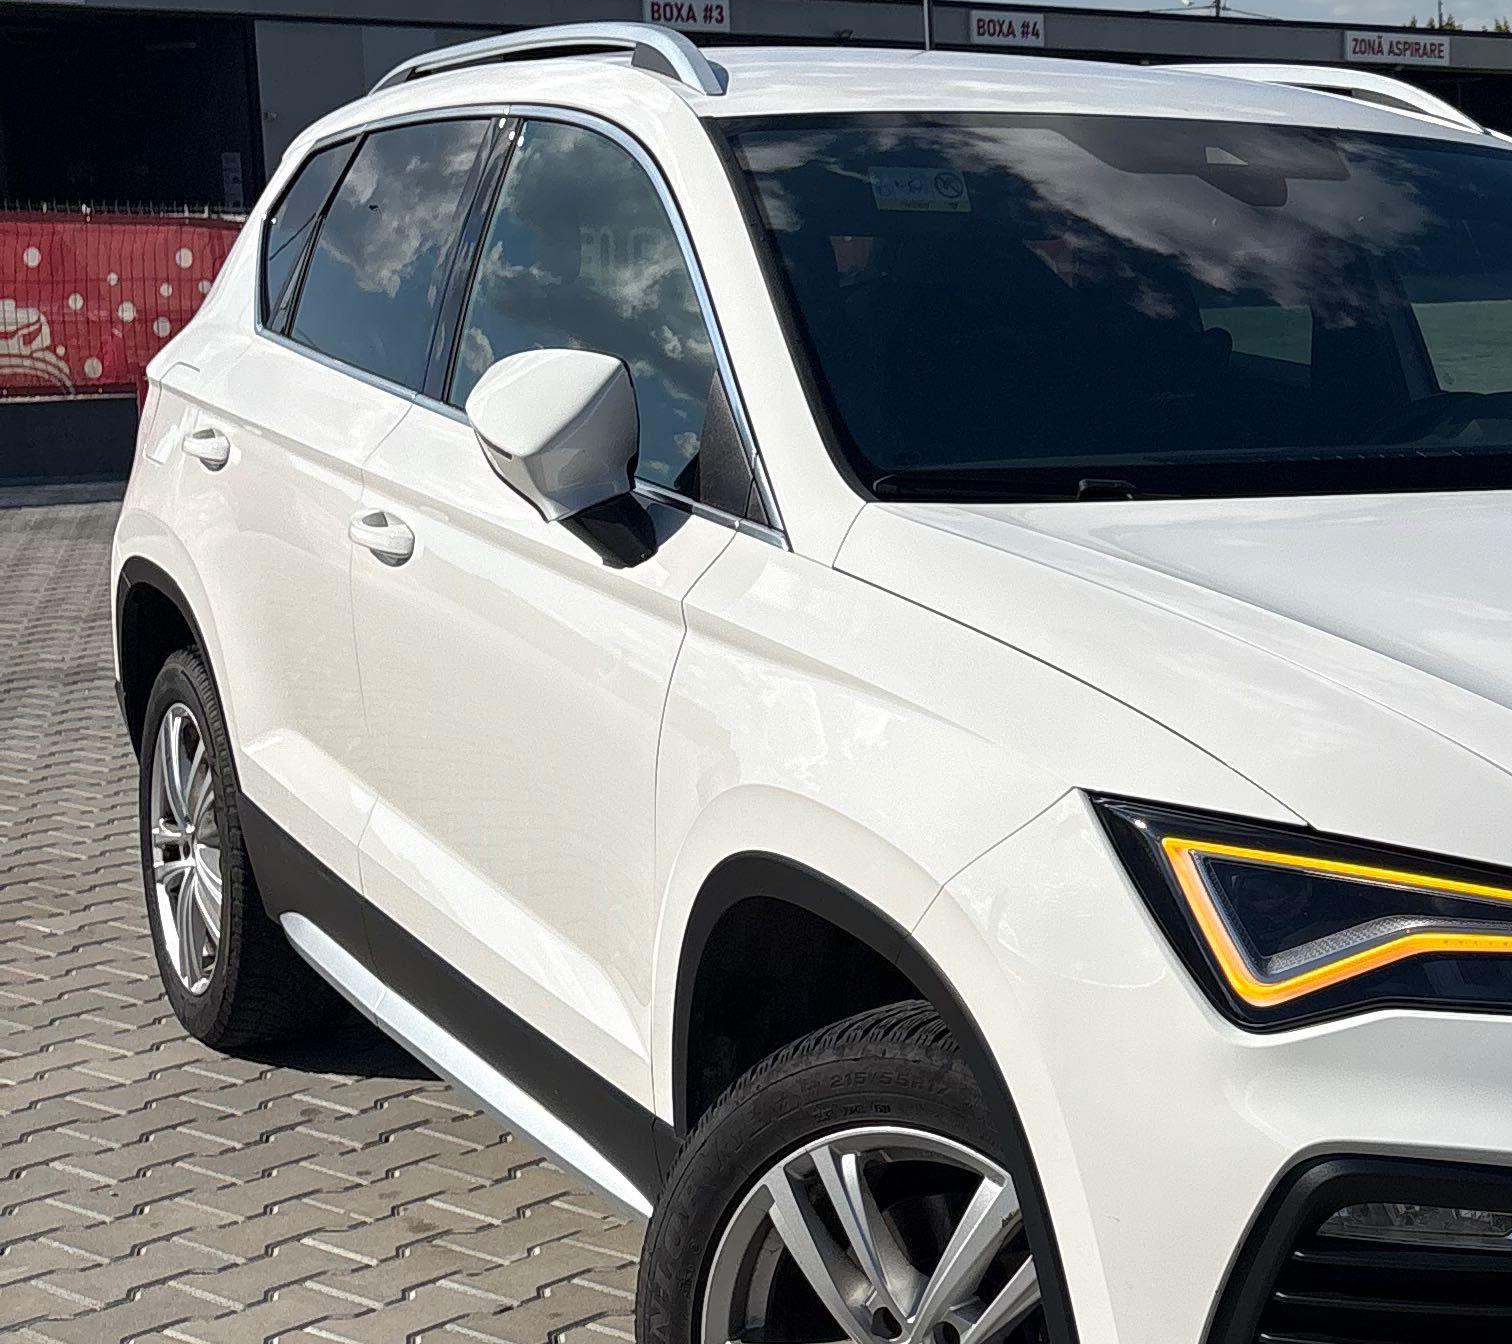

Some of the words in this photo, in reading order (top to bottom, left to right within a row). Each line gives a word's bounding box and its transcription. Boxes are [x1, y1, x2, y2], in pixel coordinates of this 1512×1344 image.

[650, 0, 698, 23] BOXA
[702, 3, 724, 25] #3
[976, 18, 1017, 39] BOXA
[1020, 20, 1040, 40] #4
[1352, 34, 1385, 57] ZONĂ
[1388, 40, 1445, 60] ASPIRARE
